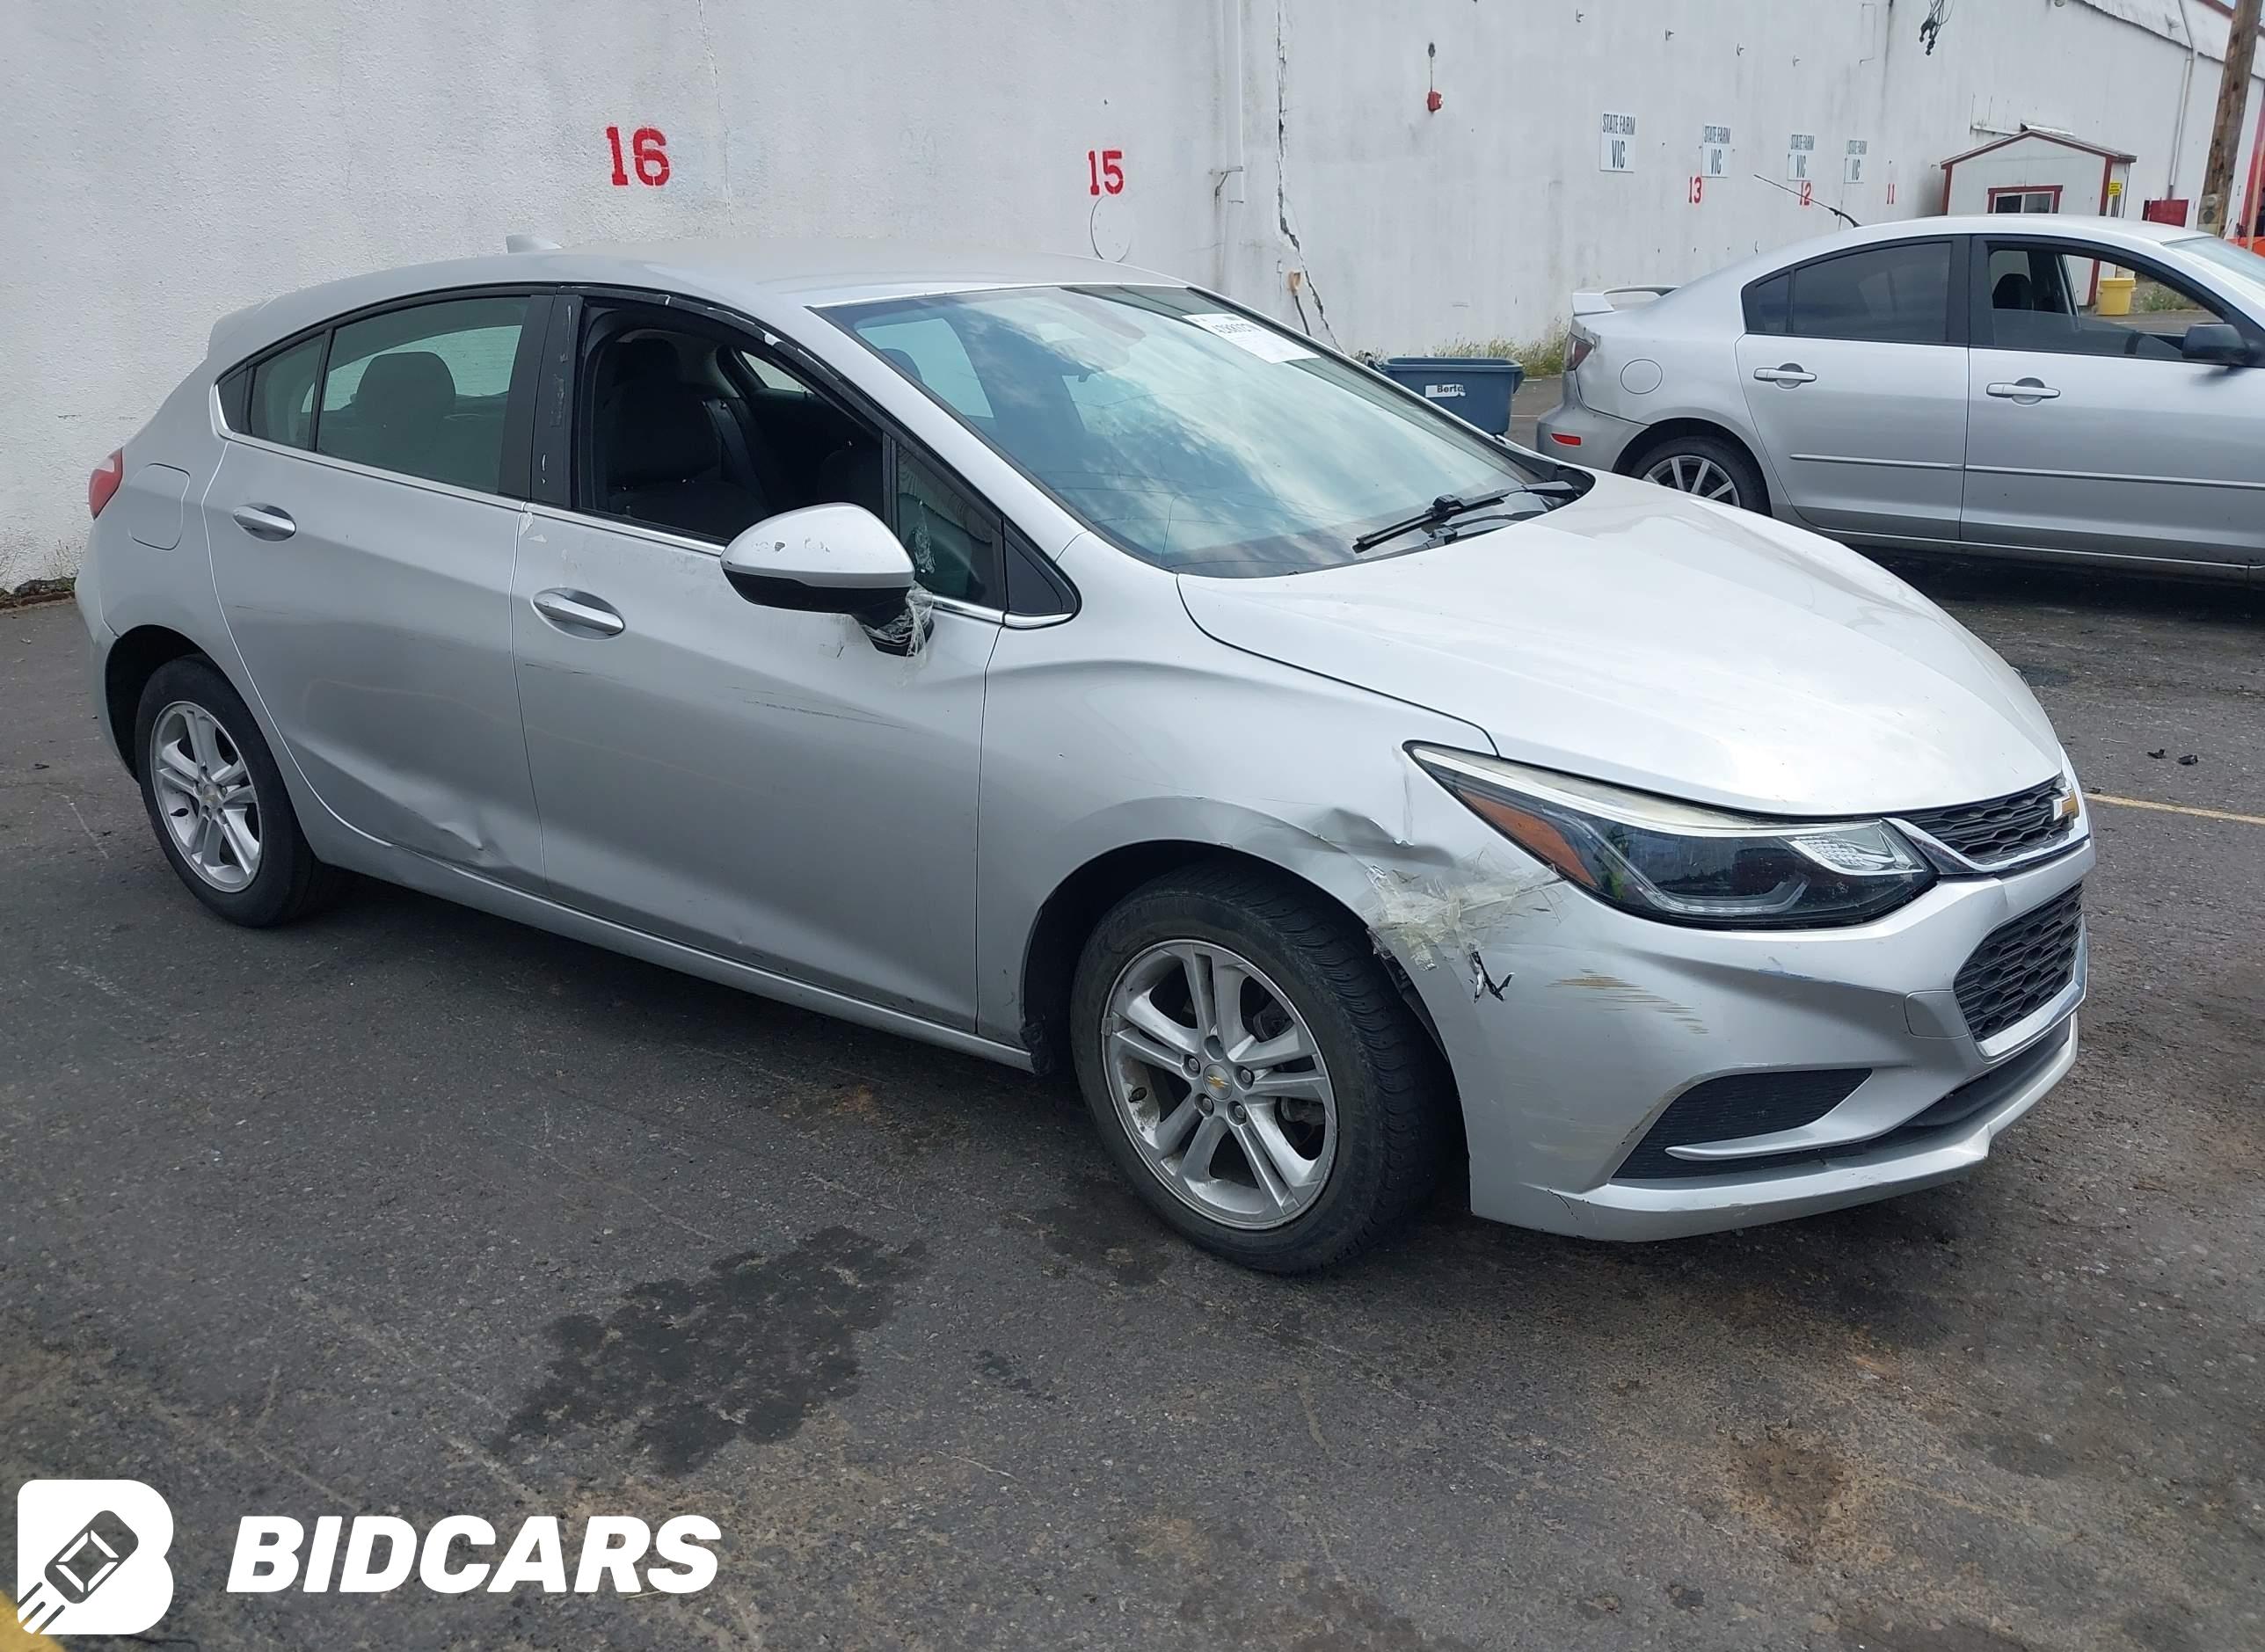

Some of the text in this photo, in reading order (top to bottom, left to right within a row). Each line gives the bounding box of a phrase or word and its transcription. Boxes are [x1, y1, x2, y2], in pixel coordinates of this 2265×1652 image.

[1602, 113, 1635, 135] STATE FARM
[1704, 126, 1731, 145] STATE FARM
[606, 127, 670, 186] 16
[1612, 139, 1626, 169] VIC
[1711, 148, 1722, 175] VIC
[1089, 150, 1124, 195] 15
[1688, 176, 1702, 203] 13
[1799, 181, 1811, 206] 12
[1886, 183, 1895, 205] 11
